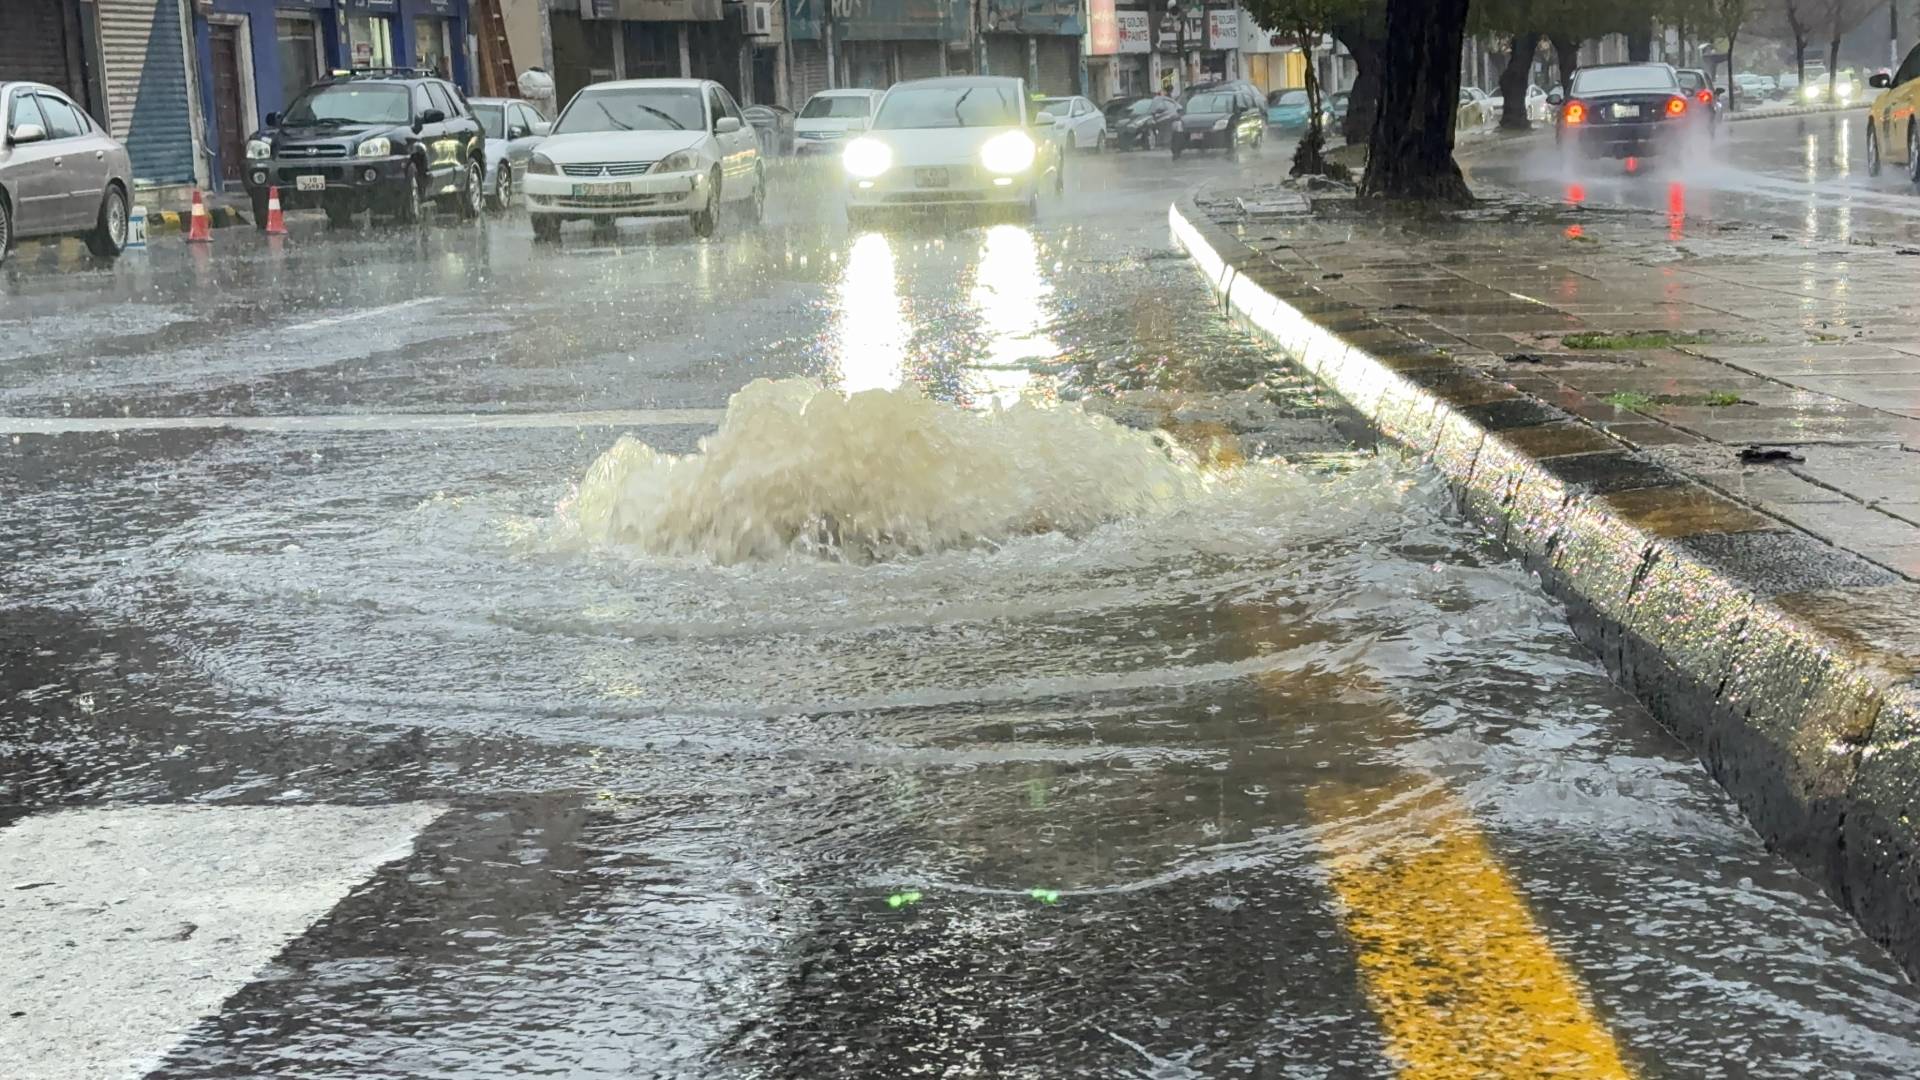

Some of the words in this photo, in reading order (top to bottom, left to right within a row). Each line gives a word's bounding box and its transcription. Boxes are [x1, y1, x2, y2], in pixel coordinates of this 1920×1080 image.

[1127, 17, 1147, 27] GOLDEN
[1219, 15, 1236, 25] GOLDEN
[1127, 30, 1148, 40] PAINTS
[1219, 26, 1237, 37] PAINTS
